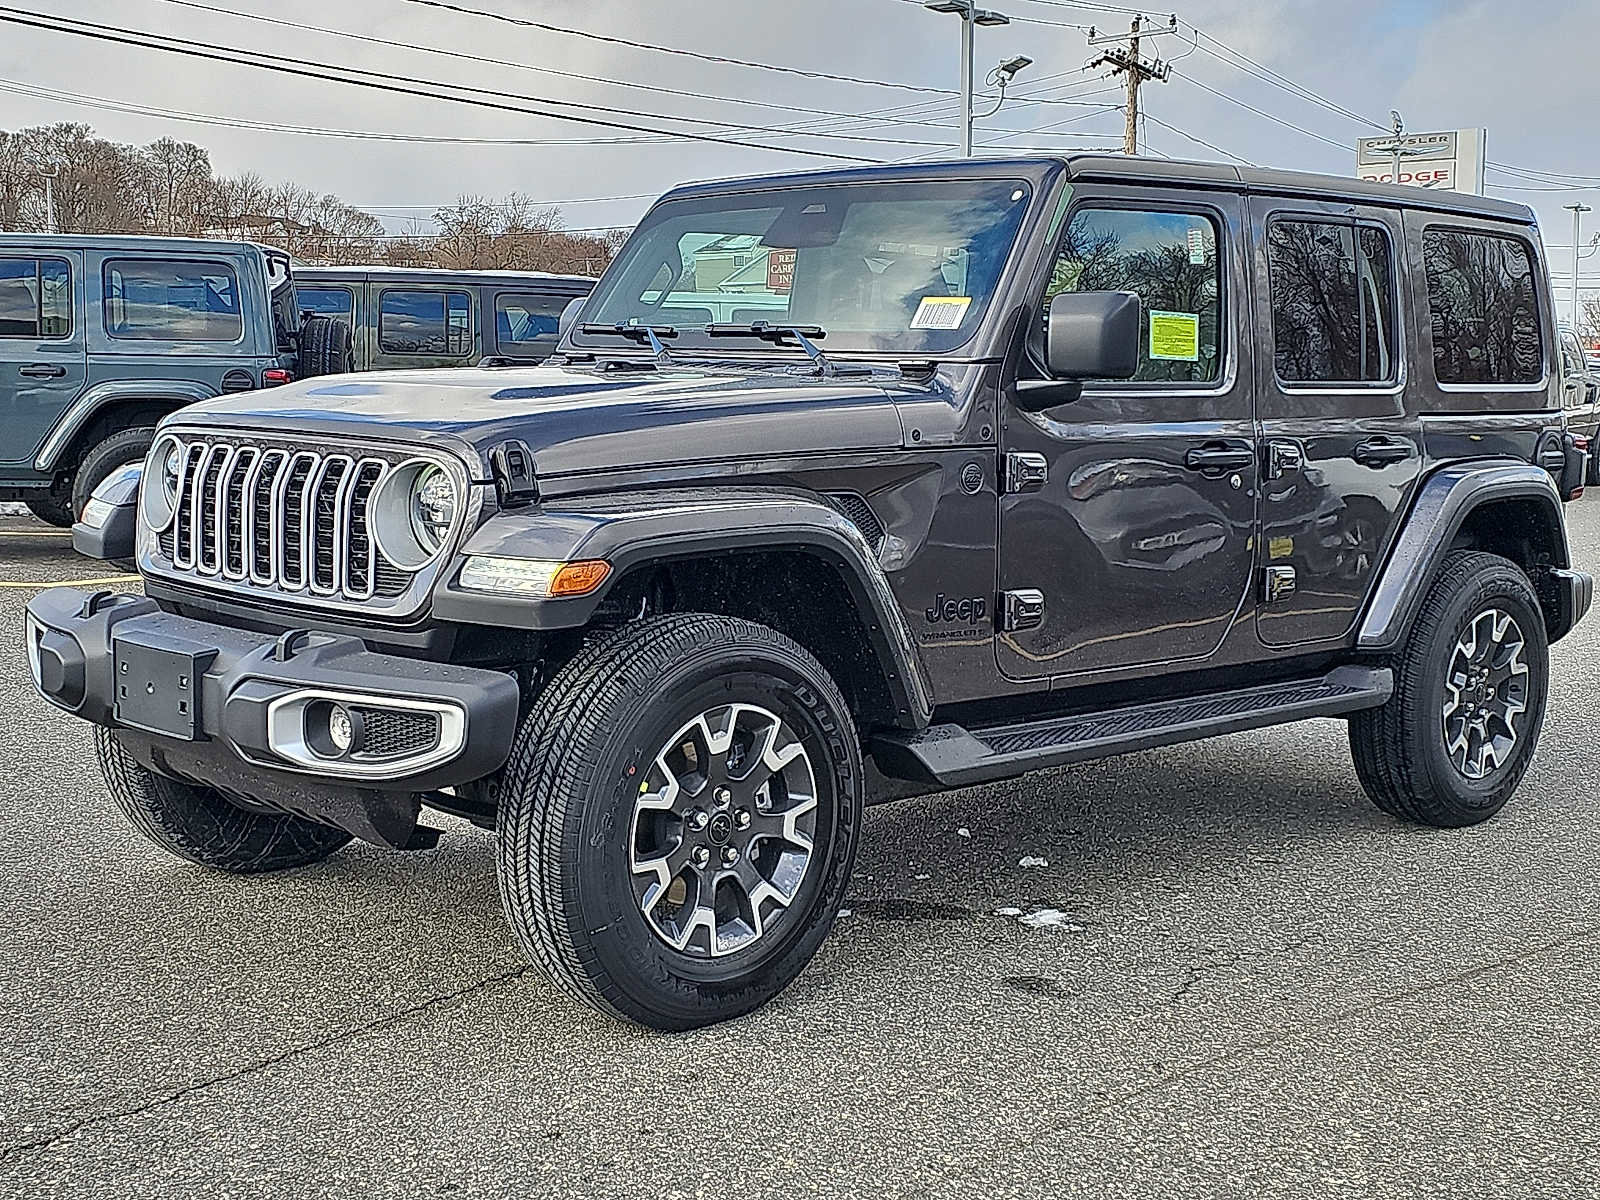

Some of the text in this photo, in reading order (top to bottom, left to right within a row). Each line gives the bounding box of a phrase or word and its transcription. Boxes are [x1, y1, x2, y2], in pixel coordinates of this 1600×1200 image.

[1366, 136, 1449, 147] CHRYSLER
[1363, 169, 1449, 183] DODGE
[926, 592, 986, 625] Jeep
